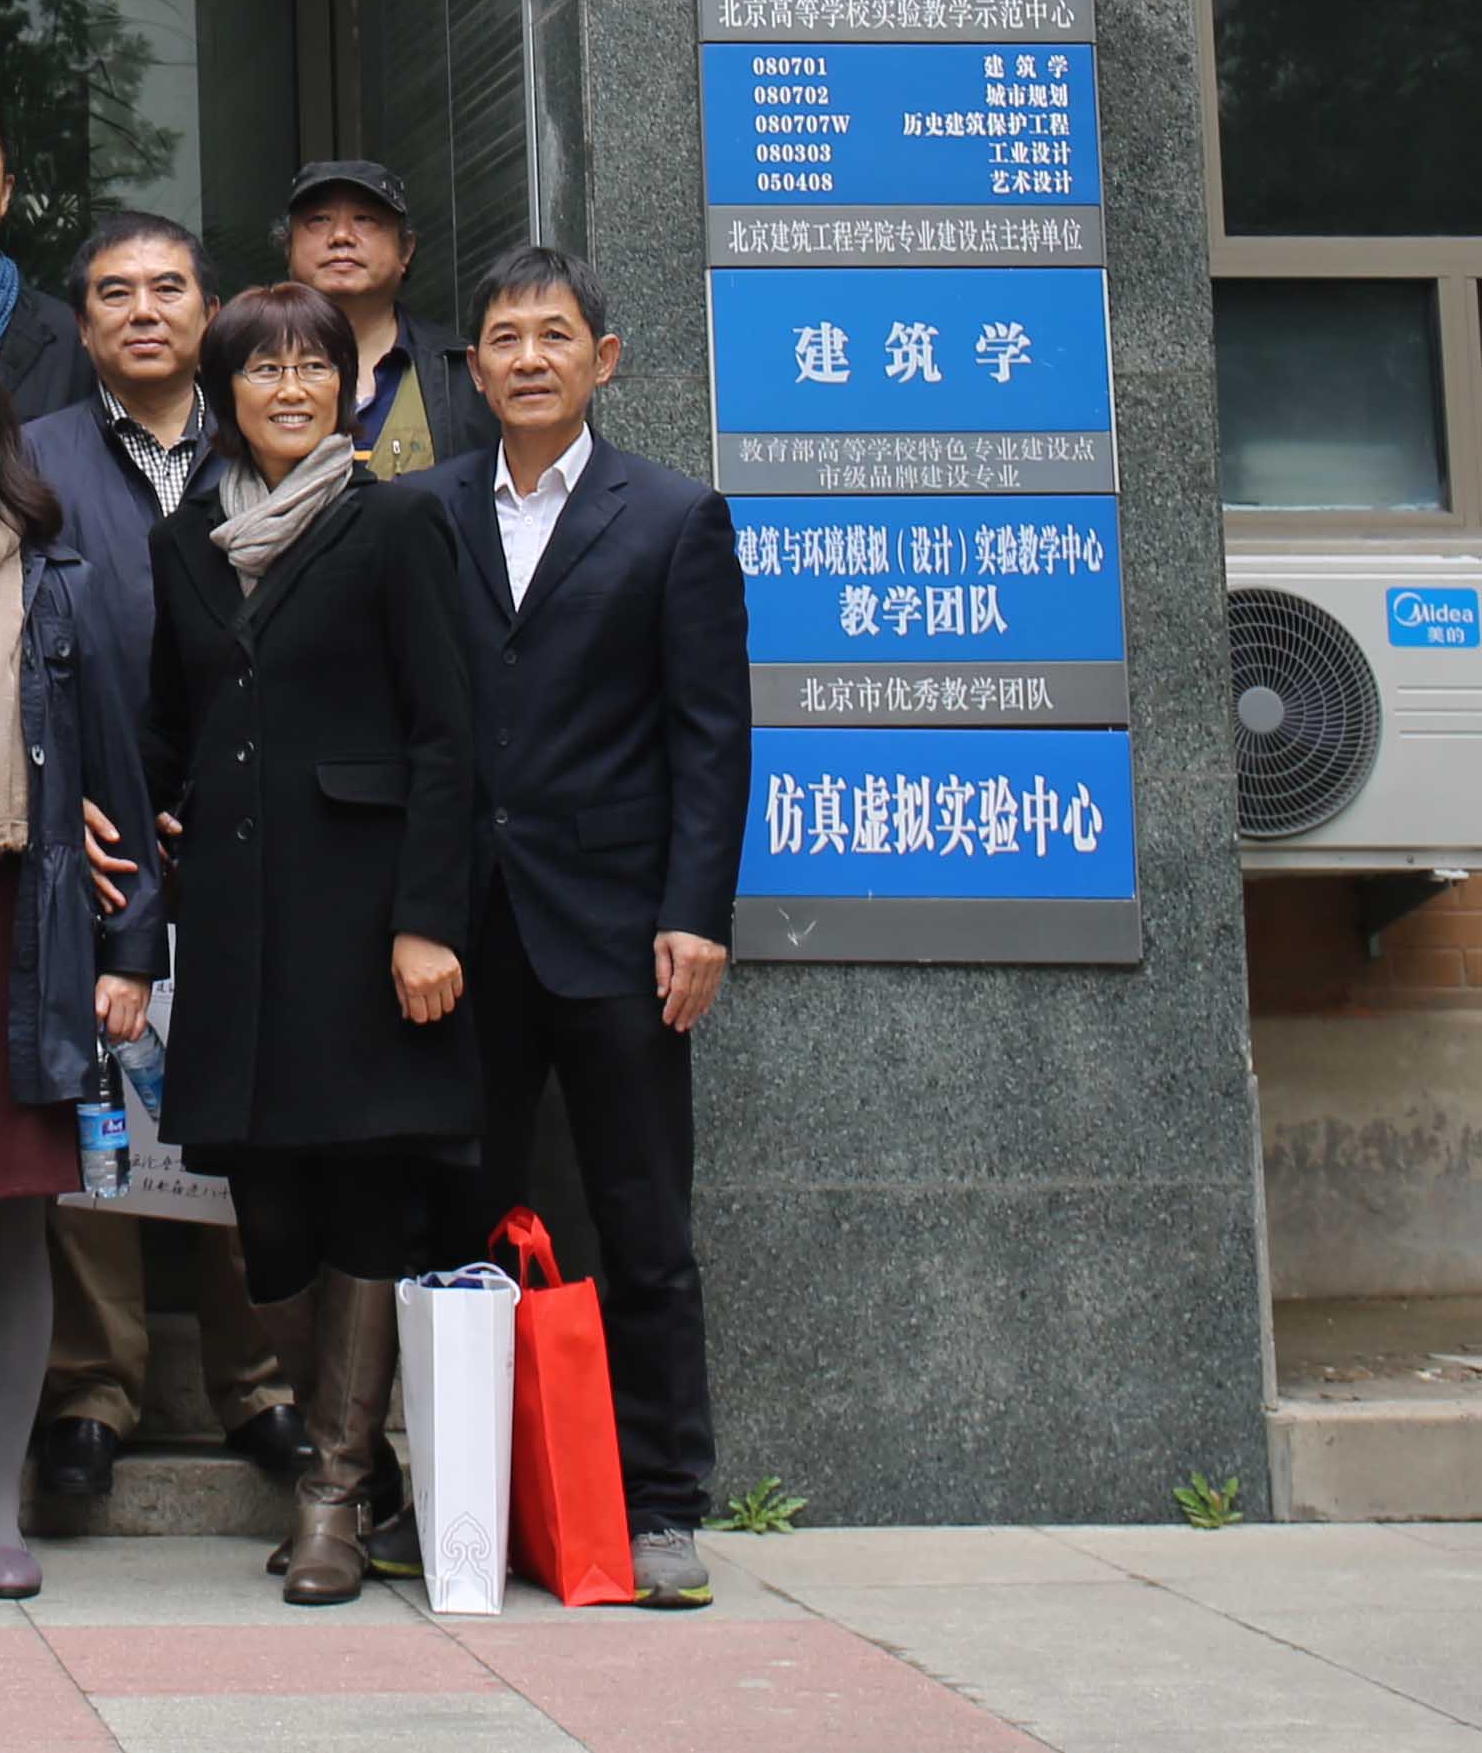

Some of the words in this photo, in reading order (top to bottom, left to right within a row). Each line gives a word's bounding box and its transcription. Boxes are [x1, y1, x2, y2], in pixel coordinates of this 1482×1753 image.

[753, 57, 827, 76] 080701
[984, 54, 1068, 78] 建筑学
[754, 85, 829, 105] 080702
[985, 83, 1068, 108] 城市规划
[755, 114, 851, 134] 080707W
[903, 111, 1070, 136] 历史建筑保护工程
[756, 143, 831, 163] 080303
[988, 141, 1072, 165] 工业设计
[757, 172, 833, 191] 050408
[990, 169, 1073, 194] 艺术设计
[728, 220, 1082, 255] 北京建筑工程学院专业建设点主持单位
[792, 321, 1033, 384] 建筑学
[740, 437, 1095, 463] 教育部高等学校特色专业建设点
[818, 464, 1021, 489] 市级品牌建设专业
[735, 524, 1104, 576] 建筑与环境模拟（设计）实验教学中心
[839, 584, 1008, 636] 教学团队
[1408, 603, 1474, 624] Midea
[800, 676, 1054, 712] 北京市优秀教学团队
[765, 773, 1103, 857] 仿真虚拟实验中心
